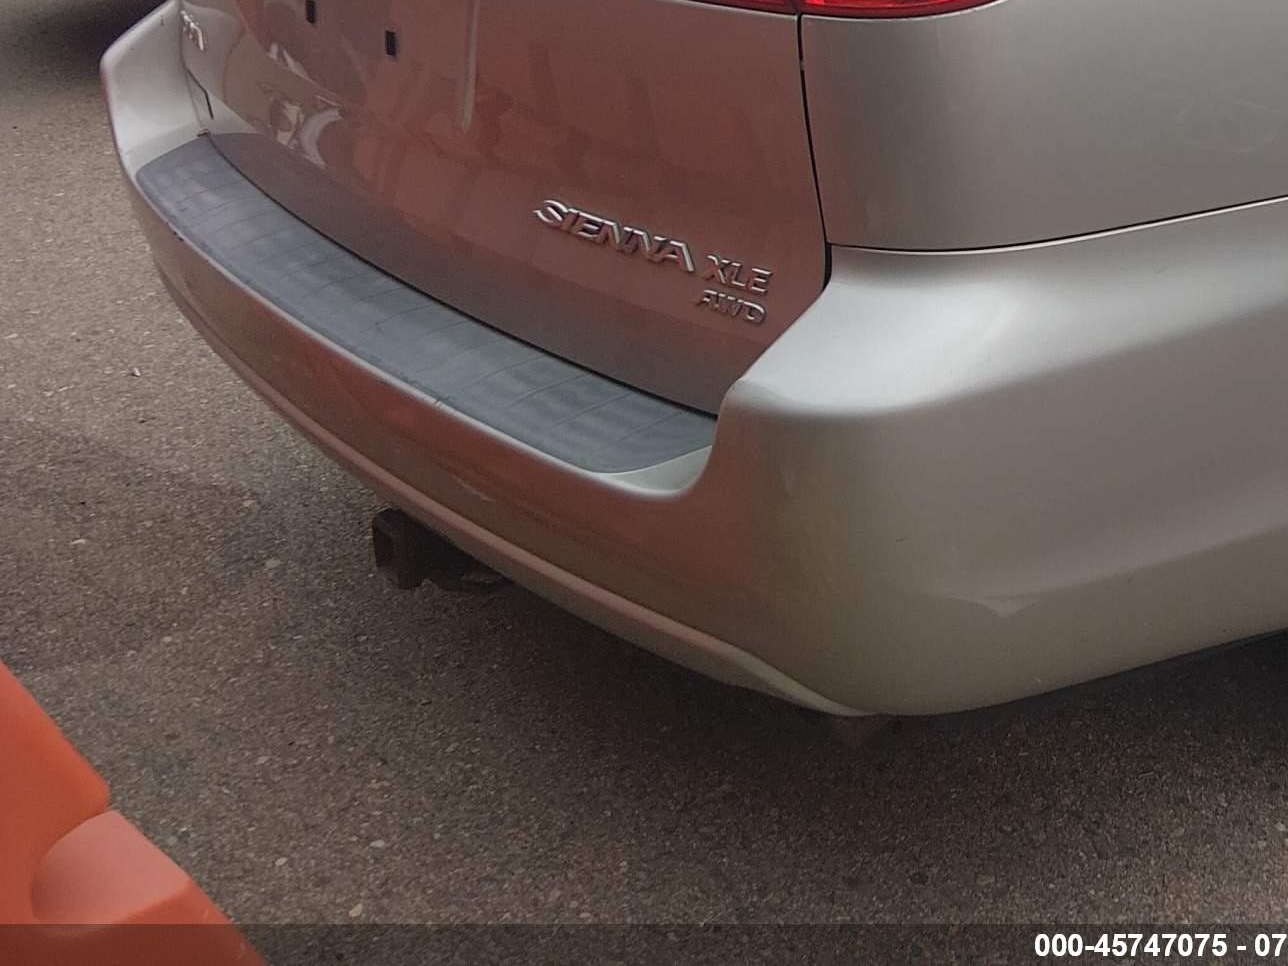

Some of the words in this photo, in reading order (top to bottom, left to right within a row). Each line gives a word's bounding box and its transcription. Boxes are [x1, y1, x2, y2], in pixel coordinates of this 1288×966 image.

[533, 199, 696, 274] SIENNA
[705, 253, 773, 296] XLE
[697, 288, 768, 325] AWD
